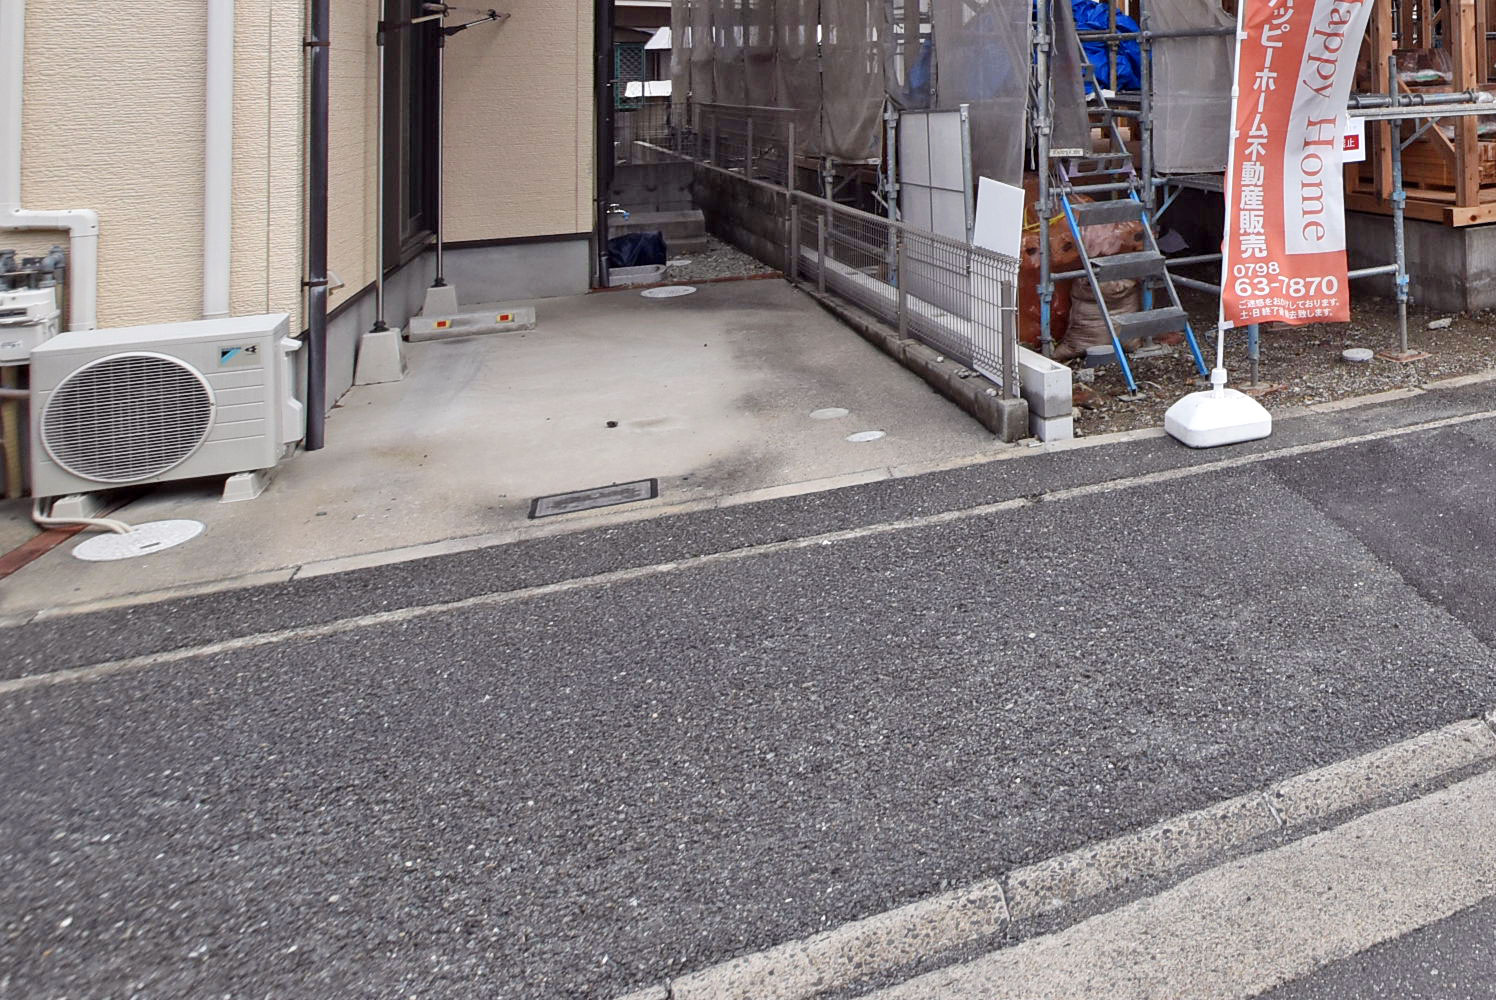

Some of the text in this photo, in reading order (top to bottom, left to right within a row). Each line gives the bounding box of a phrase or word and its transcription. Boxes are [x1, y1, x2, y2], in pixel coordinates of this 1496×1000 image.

[1301, 114, 1338, 241] Home
[1233, 261, 1280, 277] 0798
[1234, 275, 1339, 297] 63-7870
